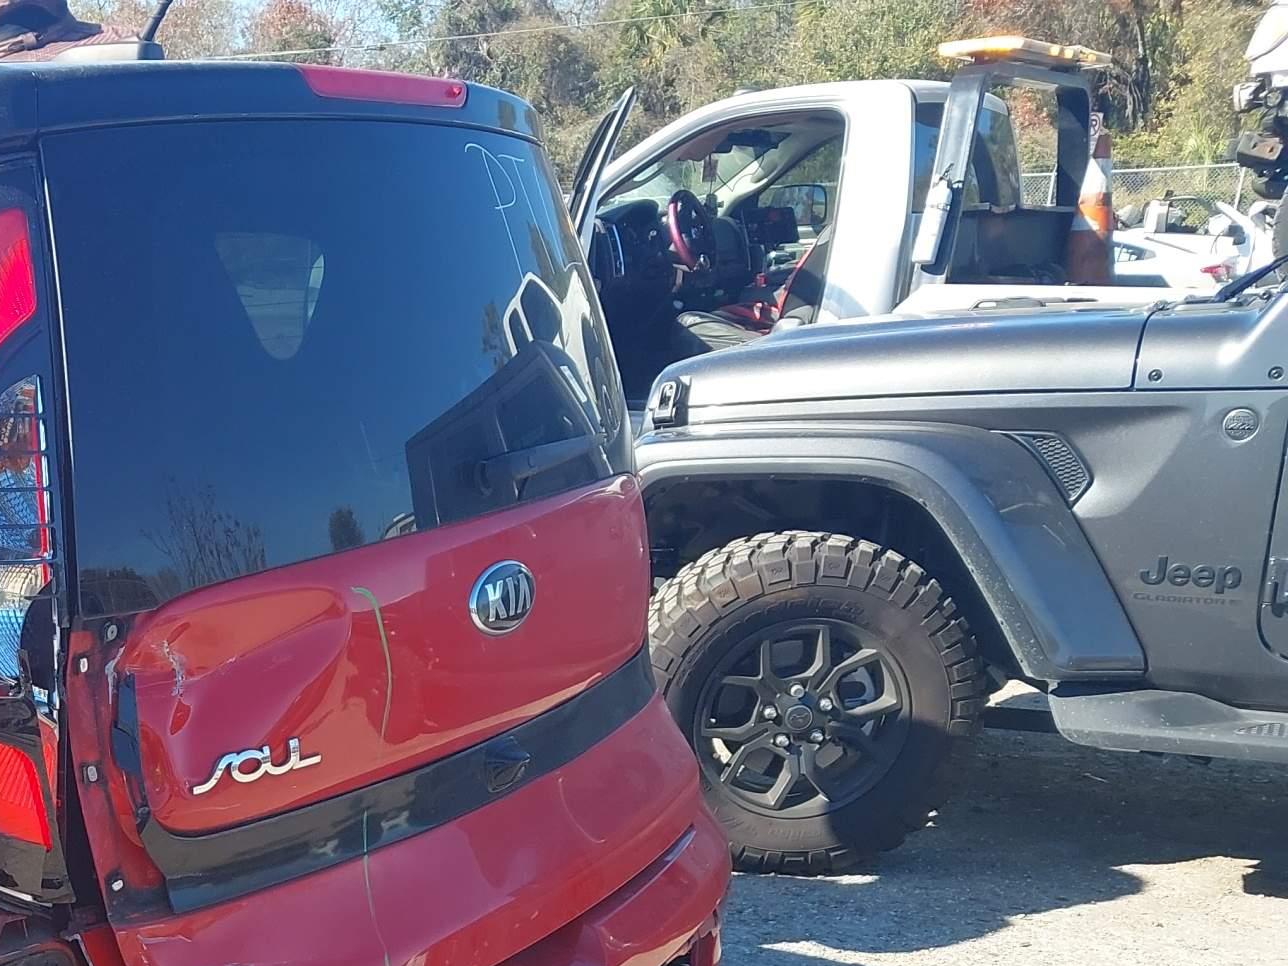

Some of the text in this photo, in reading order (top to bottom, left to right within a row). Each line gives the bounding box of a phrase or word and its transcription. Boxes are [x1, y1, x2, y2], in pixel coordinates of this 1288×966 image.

[483, 571, 533, 624] KIA
[1139, 554, 1243, 595] Jeep
[191, 736, 323, 796] SOUL
